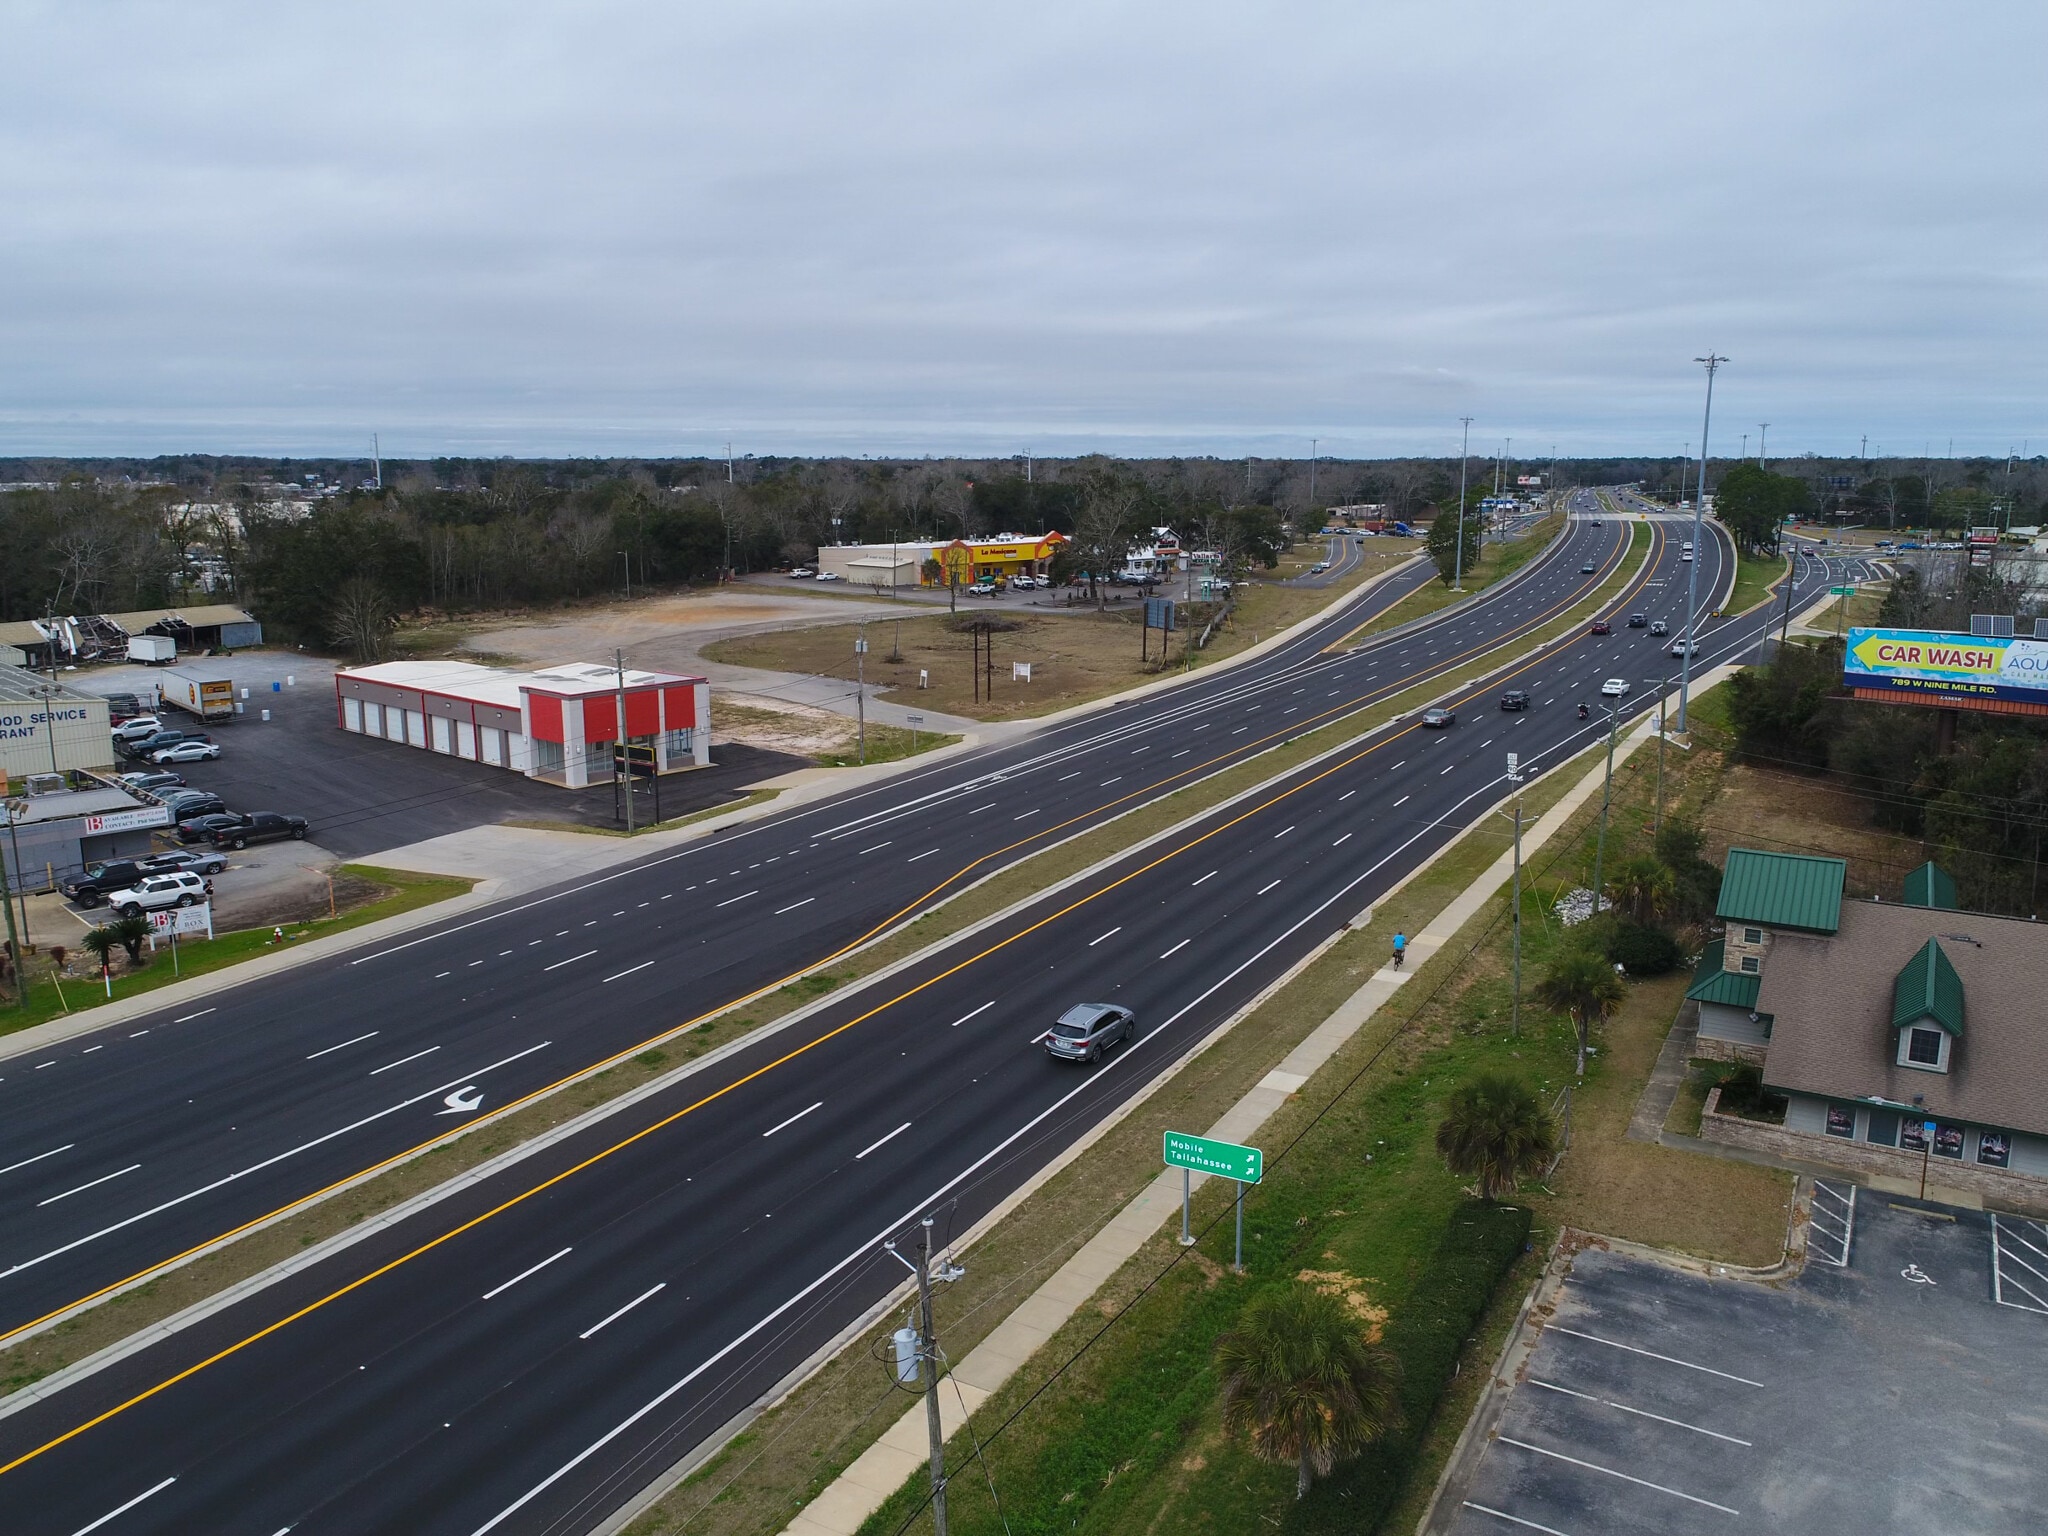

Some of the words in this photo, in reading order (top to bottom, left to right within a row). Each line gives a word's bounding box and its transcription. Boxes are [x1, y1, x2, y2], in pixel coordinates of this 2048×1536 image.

[1878, 645, 1922, 664] CAR
[1927, 648, 1994, 669] WASH
[1924, 681, 1950, 690] NINE
[1951, 684, 1977, 692] MILE
[1979, 686, 1997, 694] RD.
[30, 709, 87, 724] SERVICE
[1170, 1139, 1204, 1153] Mobile
[1170, 1150, 1232, 1171] Tallahassee
